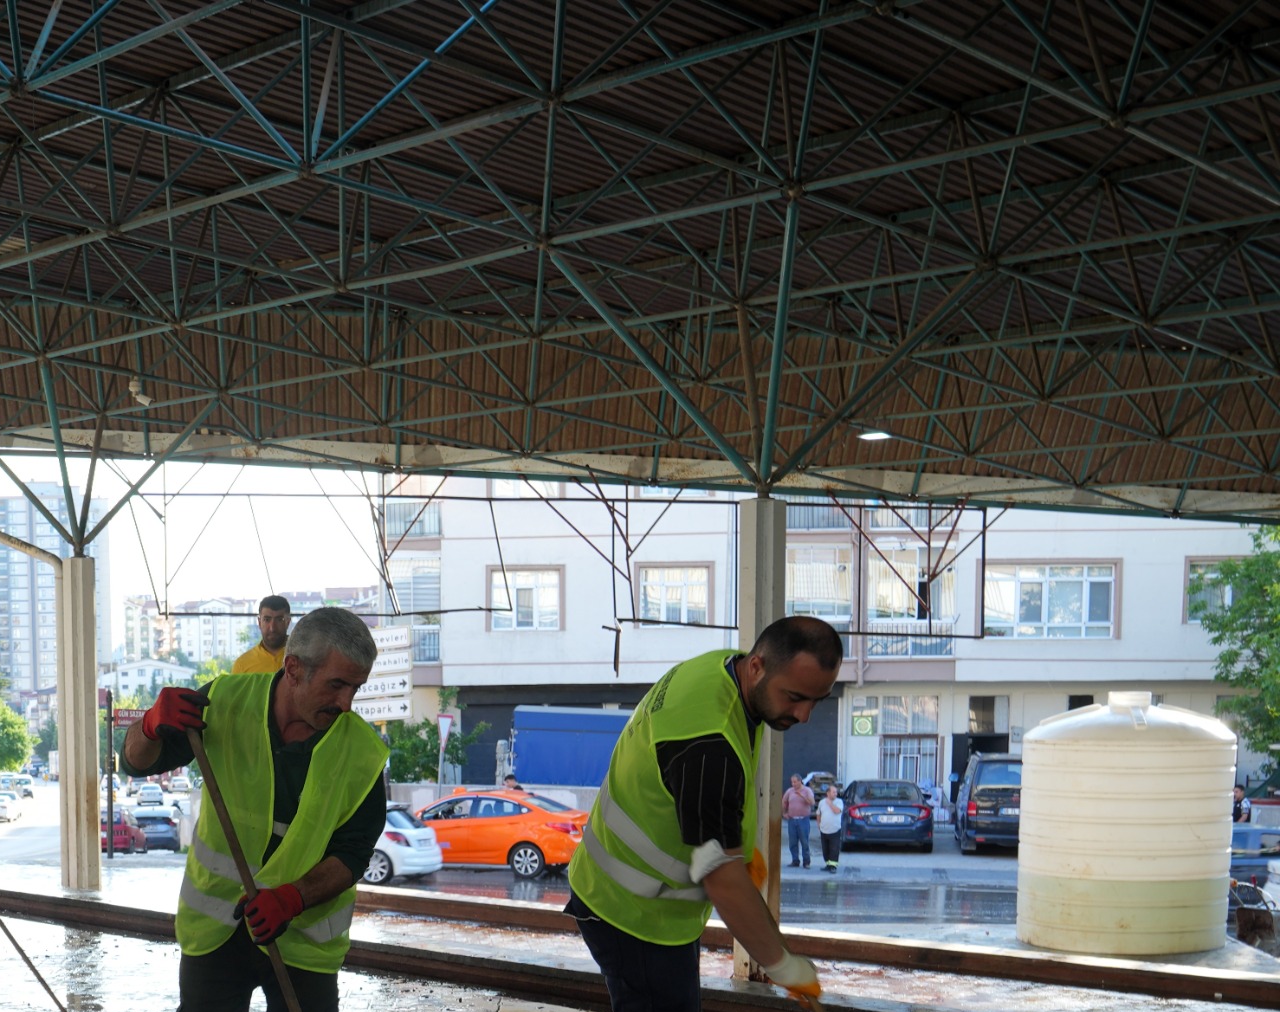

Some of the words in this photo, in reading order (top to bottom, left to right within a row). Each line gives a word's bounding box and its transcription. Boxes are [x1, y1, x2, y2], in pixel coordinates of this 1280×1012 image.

[374, 633, 407, 643] nevleri
[374, 657, 408, 666] mahalle
[118, 709, 129, 717] GÜN
[354, 704, 393, 716] Atapark
